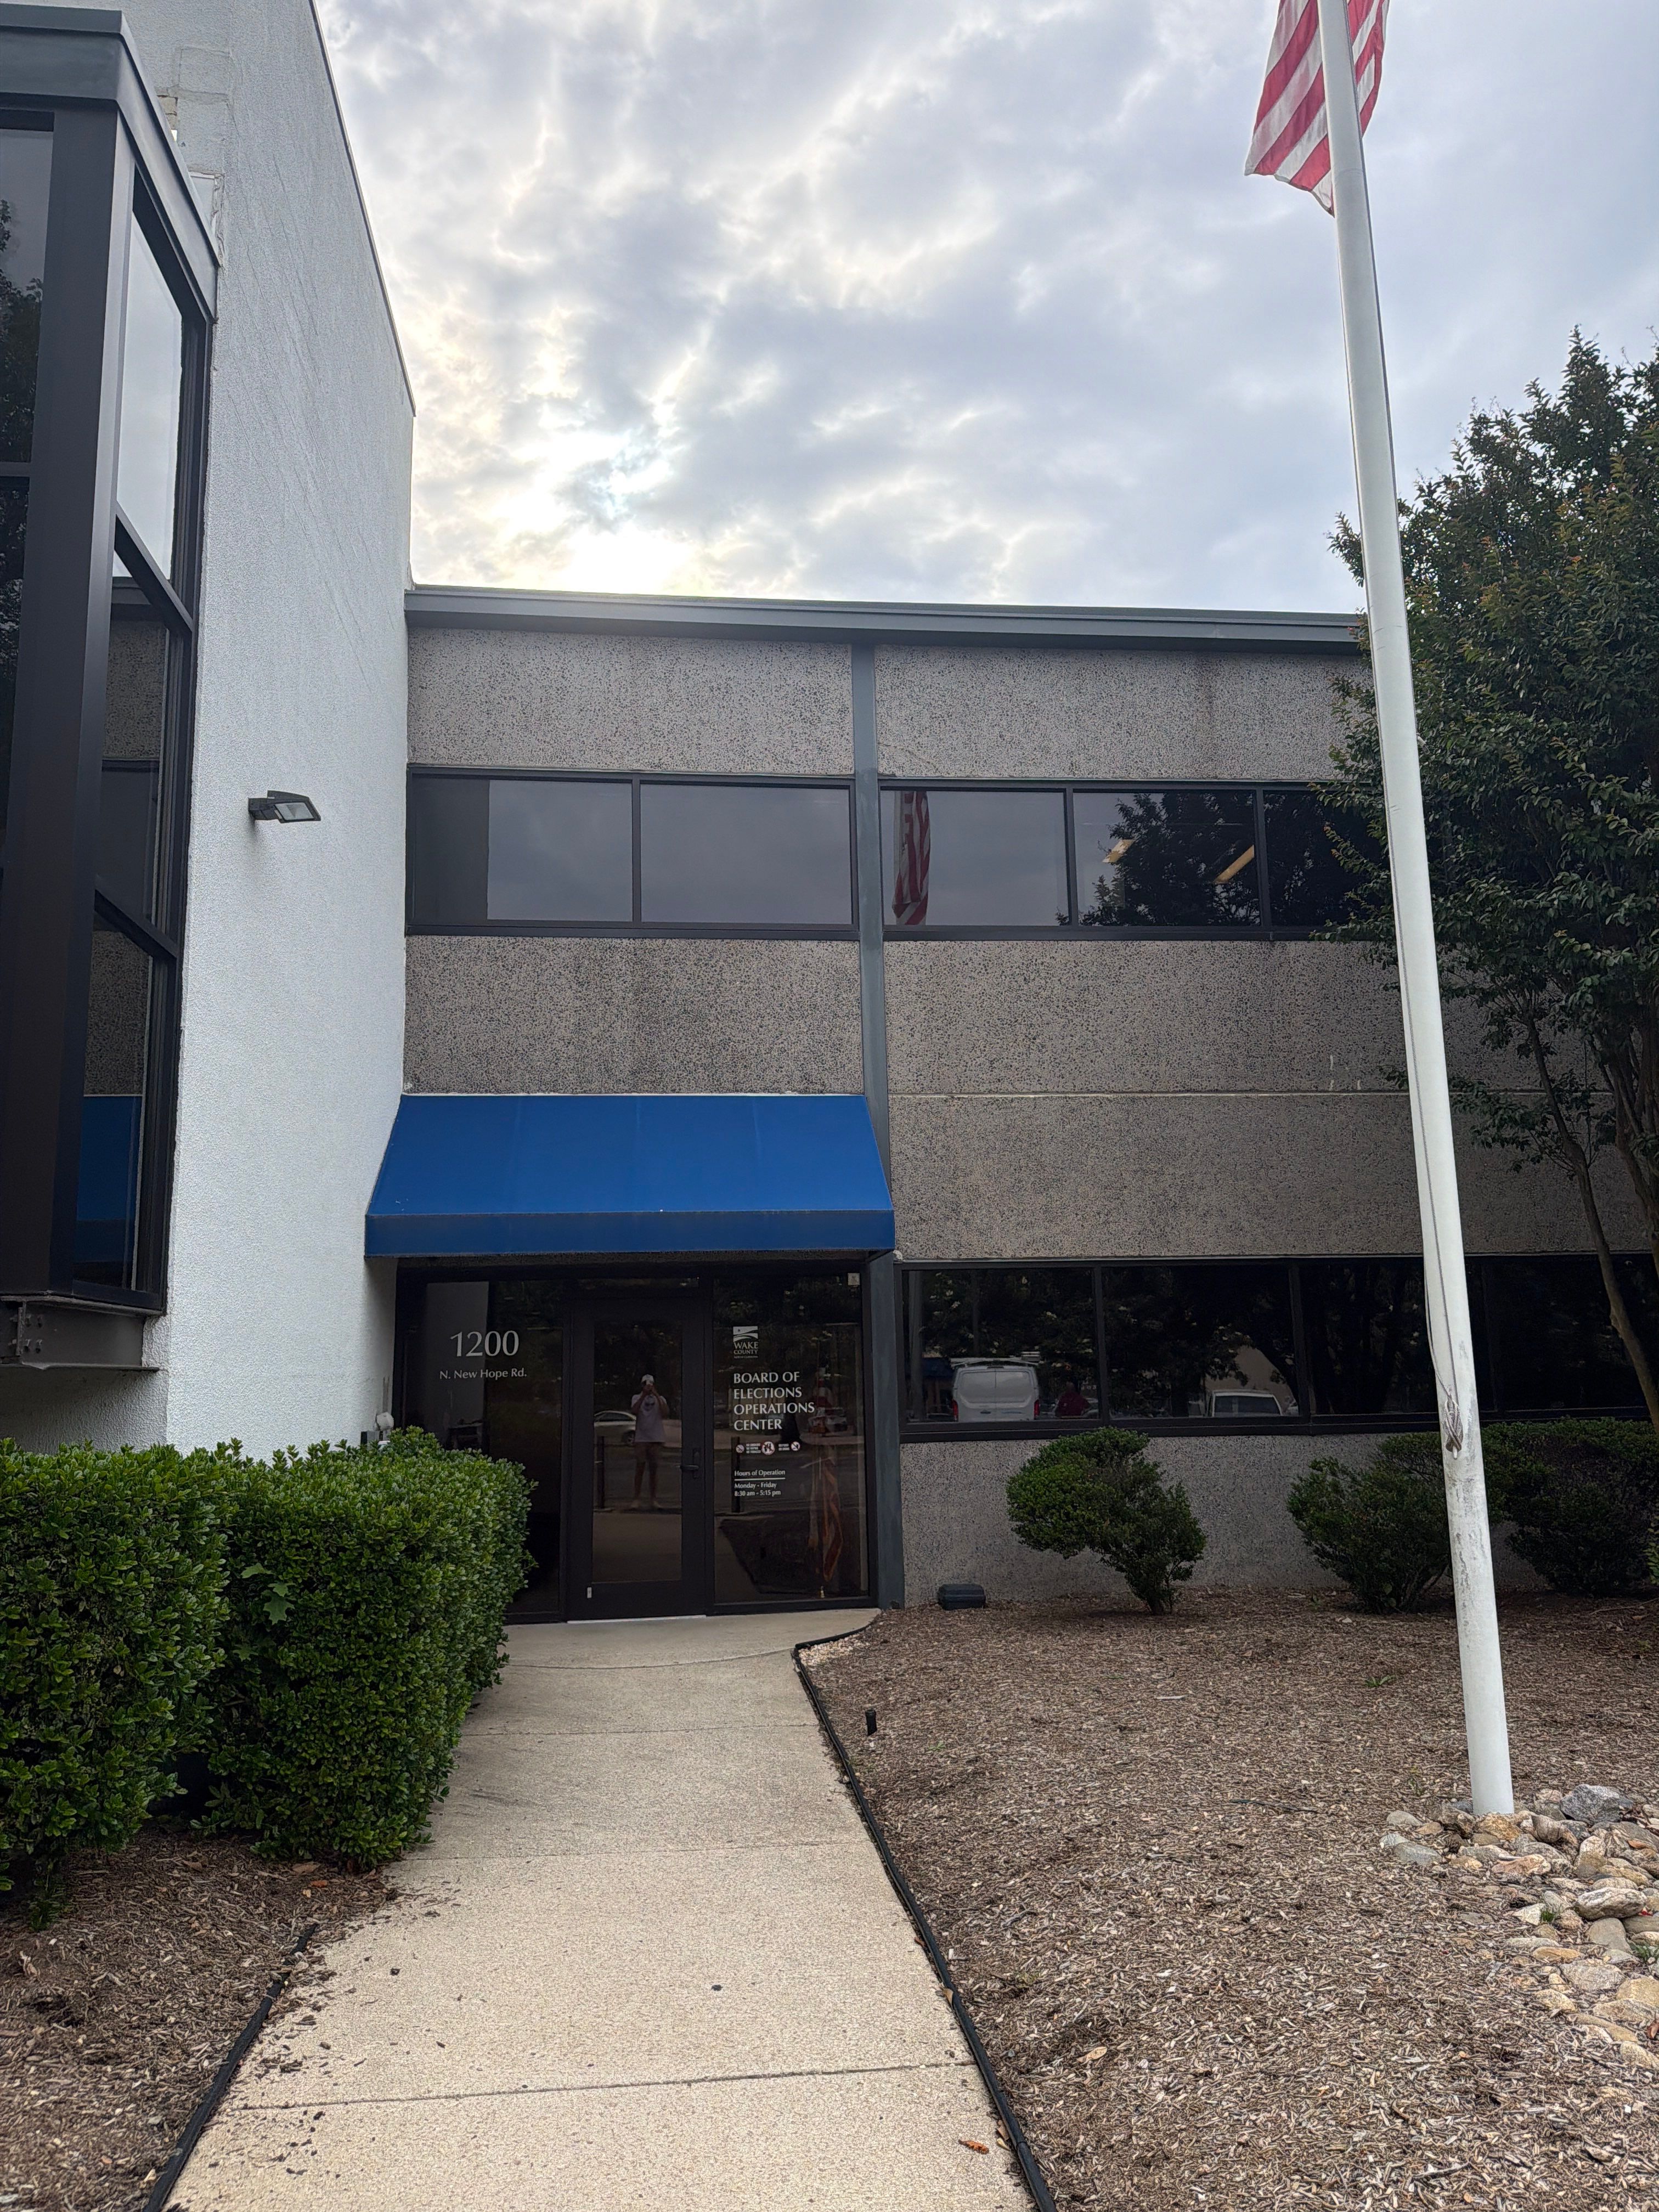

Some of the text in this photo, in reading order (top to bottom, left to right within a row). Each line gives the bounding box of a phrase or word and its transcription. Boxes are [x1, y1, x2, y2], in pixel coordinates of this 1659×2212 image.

[450, 1330, 519, 1356] 1200
[439, 1368, 527, 1380] N. New Hope Rd.
[733, 1372, 800, 1384] BOARD OF
[733, 1386, 802, 1399] ELECTIONS
[733, 1402, 815, 1415] OPERATIONS
[734, 1419, 782, 1431] CENTER
